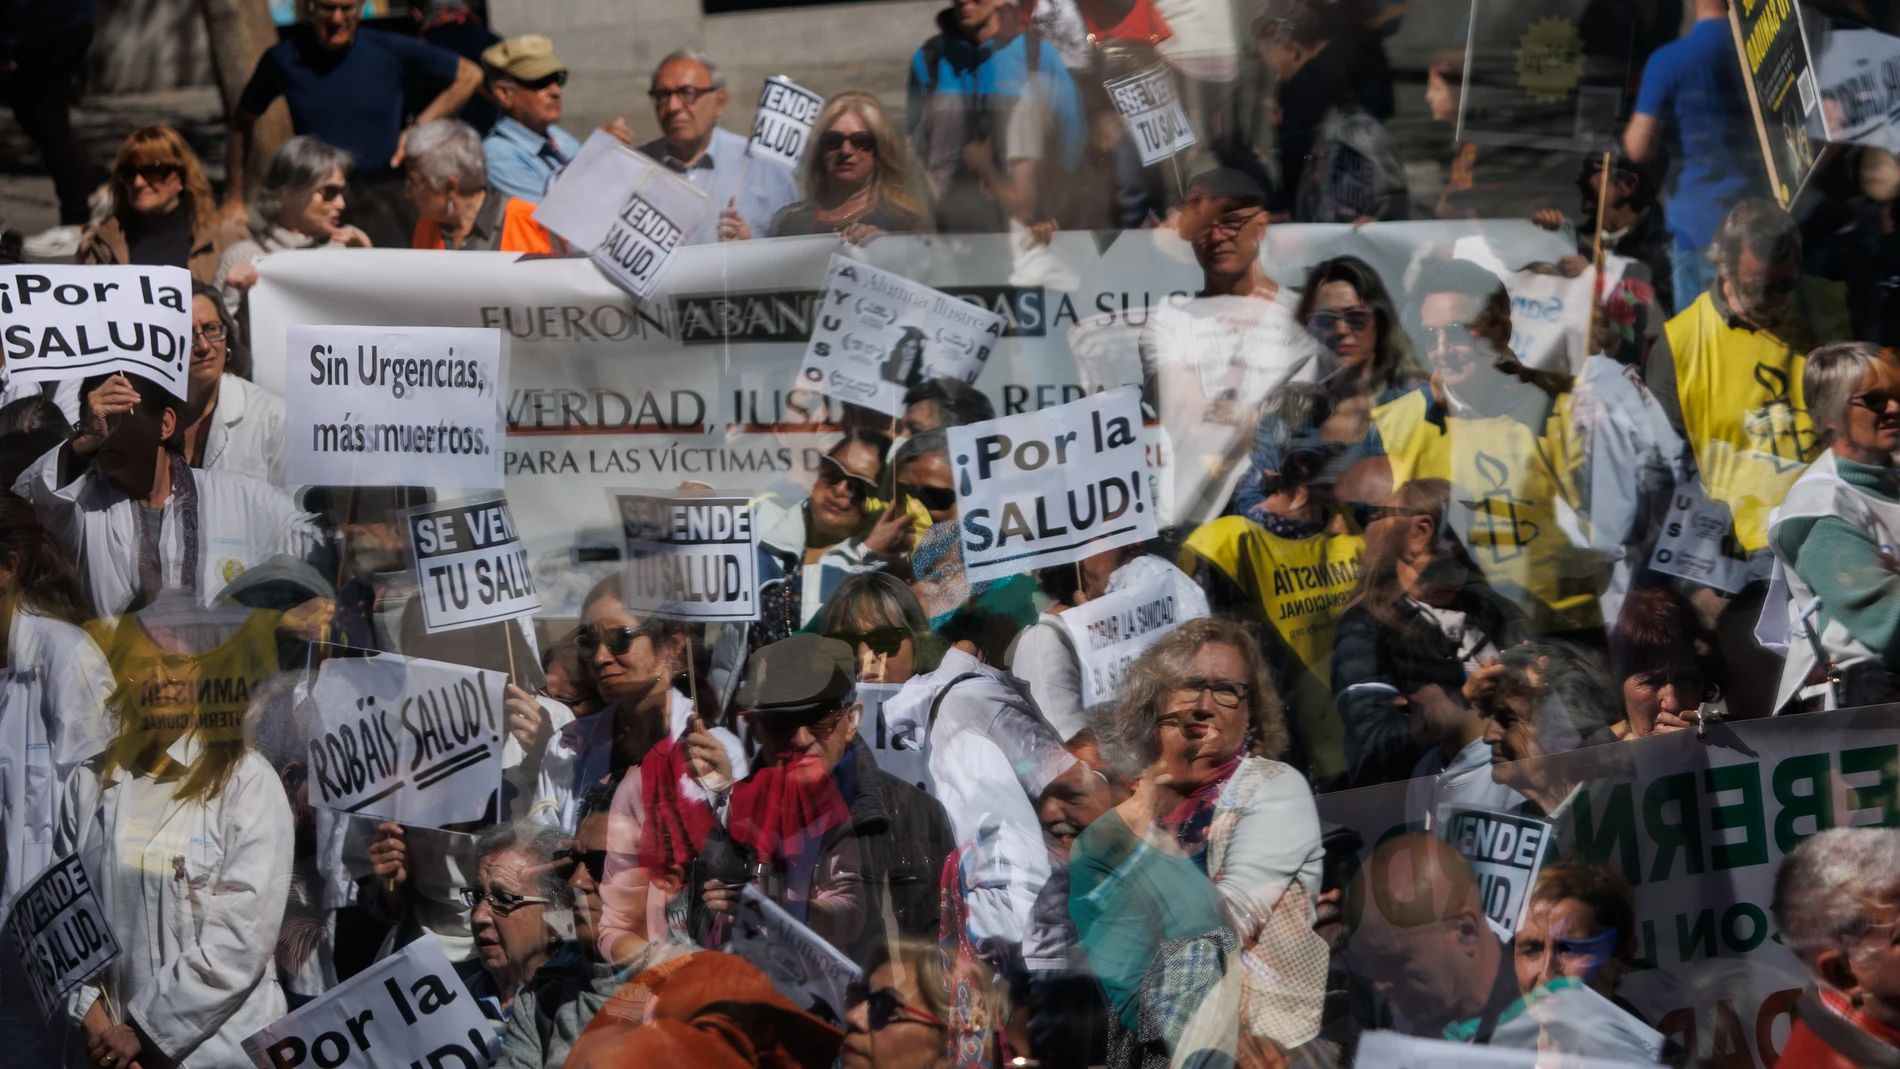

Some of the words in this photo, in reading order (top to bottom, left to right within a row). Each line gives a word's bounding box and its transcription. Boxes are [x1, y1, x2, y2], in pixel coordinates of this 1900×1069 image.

[0, 274, 119, 314] ¡Por
[139, 275, 186, 313] la
[1053, 292, 1082, 327] A
[1095, 291, 1150, 328] SU
[5, 321, 186, 373] SALUD!
[310, 344, 348, 386] Sin
[358, 345, 485, 399] Urgencias,
[313, 412, 366, 452] más
[957, 431, 1077, 497] ¡Por
[1091, 410, 1136, 453] la
[503, 450, 579, 474] PARA
[589, 449, 641, 473] LAS
[648, 441, 793, 473] VÍCTIMAS
[417, 516, 458, 553] SE
[963, 470, 1144, 552] SALUD!
[428, 563, 468, 612] TU
[401, 670, 499, 772] SALUD!
[265, 1009, 374, 1069] Por
[383, 974, 458, 1026] la
